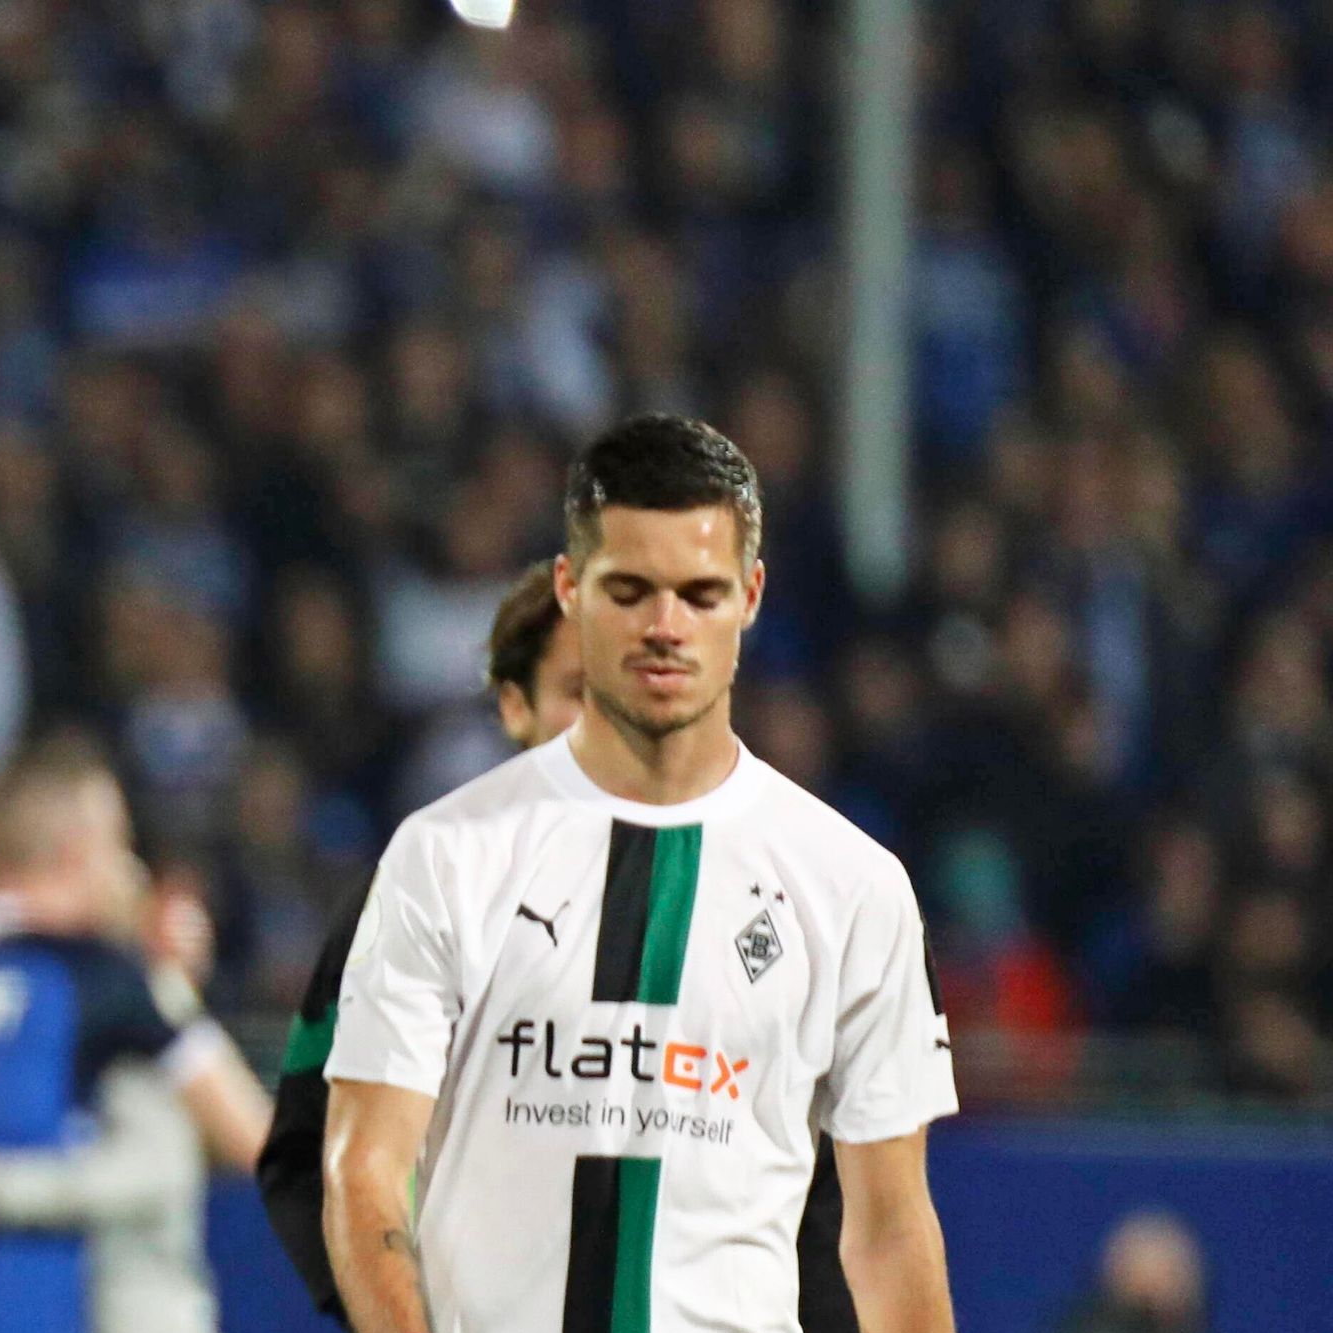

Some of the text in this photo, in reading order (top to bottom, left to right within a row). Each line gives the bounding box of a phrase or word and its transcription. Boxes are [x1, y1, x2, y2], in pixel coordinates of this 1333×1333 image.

[505, 1096, 736, 1145] Invest in yourself
